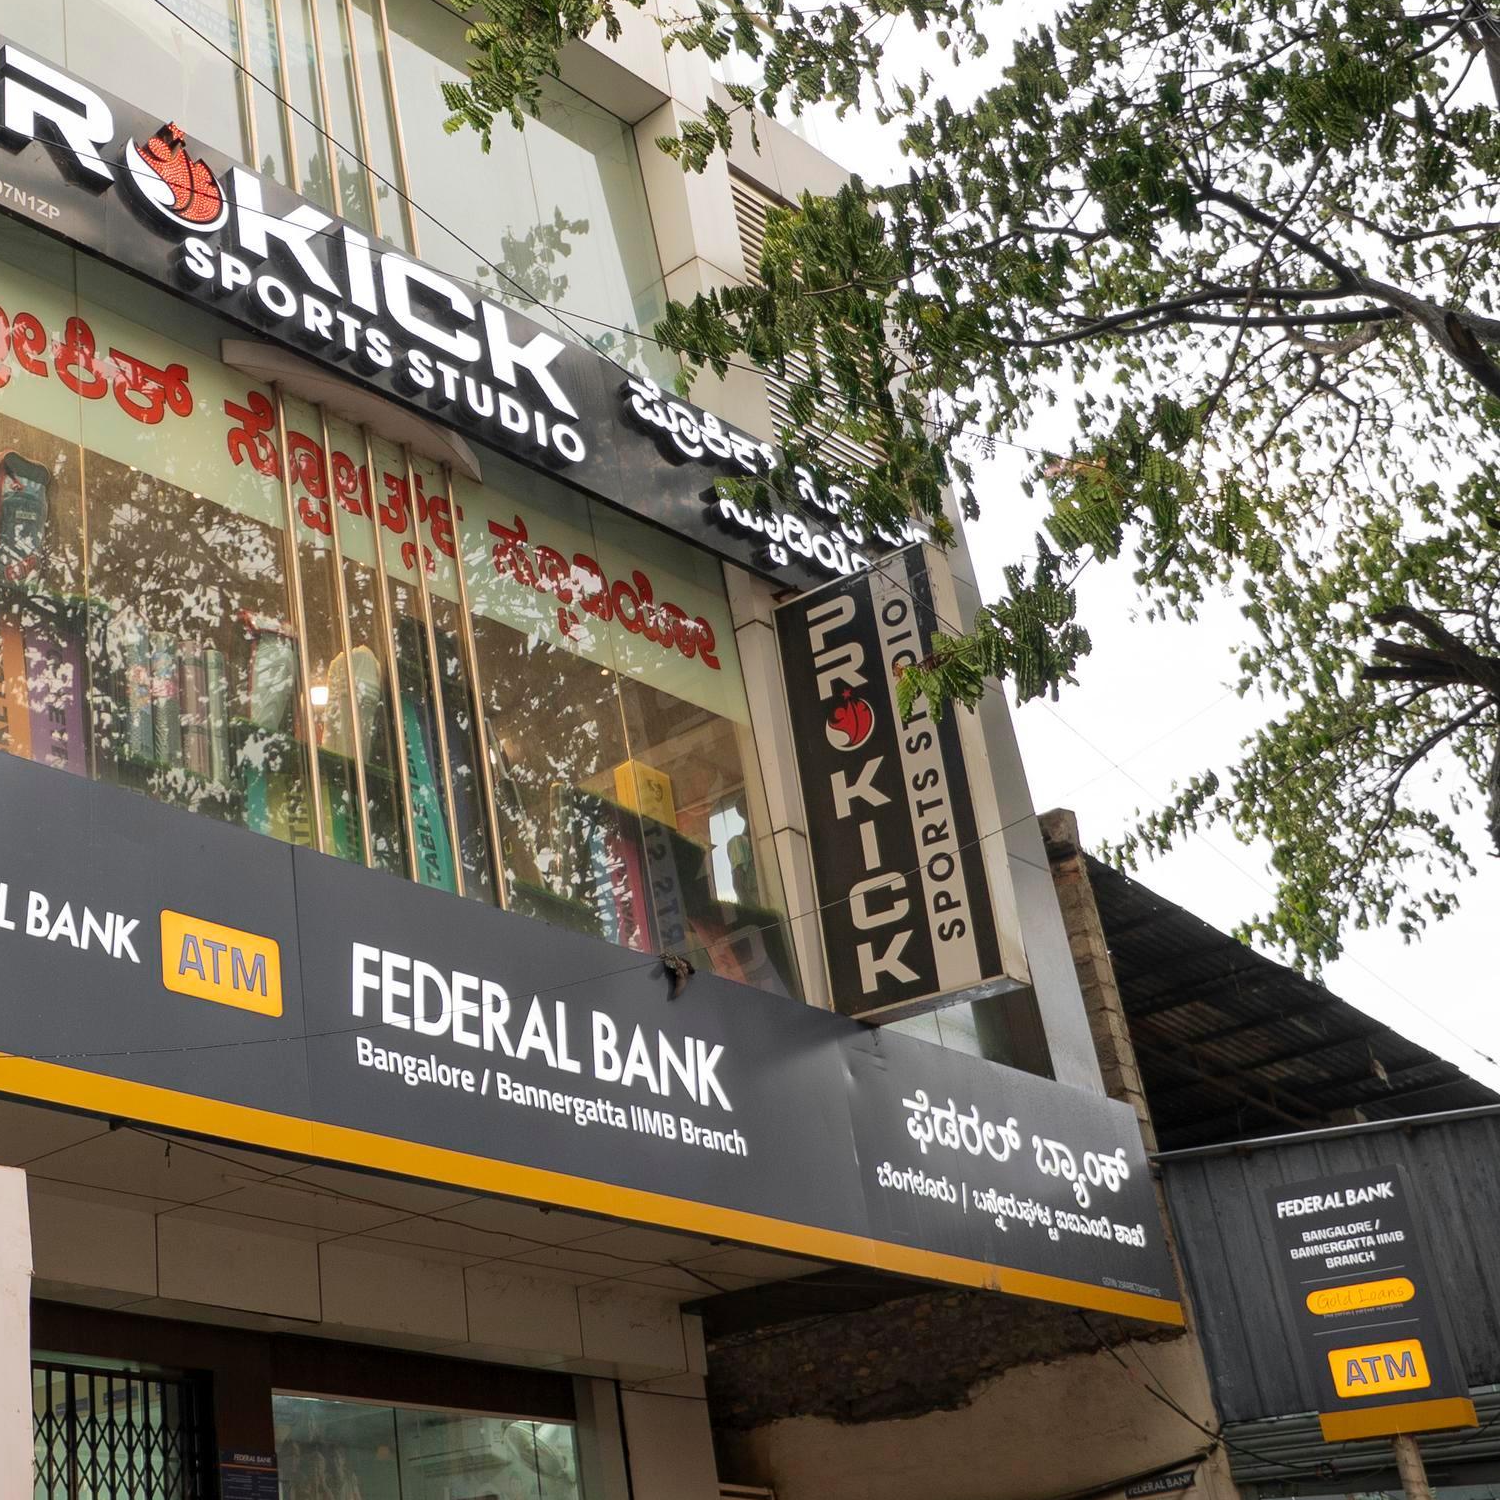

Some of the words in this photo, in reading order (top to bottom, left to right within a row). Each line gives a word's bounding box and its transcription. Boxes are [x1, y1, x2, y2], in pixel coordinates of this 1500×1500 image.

[183, 236, 393, 368] SPORTS
[406, 348, 587, 465] STUDIO
[911, 757, 967, 941] SPORTS
[25, 889, 141, 964] BANK
[177, 932, 268, 998] ATM
[351, 941, 581, 1074] FEDERAL
[593, 1009, 734, 1112] BANK
[356, 1035, 476, 1095] Bangalore
[496, 1070, 628, 1130] Bannergatta
[632, 1095, 677, 1138] IIMB
[681, 1102, 749, 1158] Branch
[902, 1089, 1021, 1162] ಫೆಡರಲ್
[1032, 1134, 1130, 1208] ಬ್ಯಾಂಕ್
[876, 1161, 956, 1203] ಬೆಂಗಳೂರು
[1114, 1223, 1146, 1248] ಶಾಖೆ
[1276, 1190, 1344, 1220] FEDERAL
[1345, 1181, 1395, 1206] BANK
[1290, 1236, 1376, 1260] BANNERGATTA
[1376, 1230, 1406, 1245] IIMB
[1301, 1220, 1373, 1243] BANGALORE
[1325, 1250, 1376, 1269] BRANCH
[1316, 1288, 1353, 1311] Gold
[1358, 1284, 1405, 1305] Loans
[1346, 1350, 1418, 1387] ATM
[233, 1452, 256, 1463] FEDERAL
[256, 1455, 272, 1464] BANK
[1167, 1473, 1193, 1489] BANK
